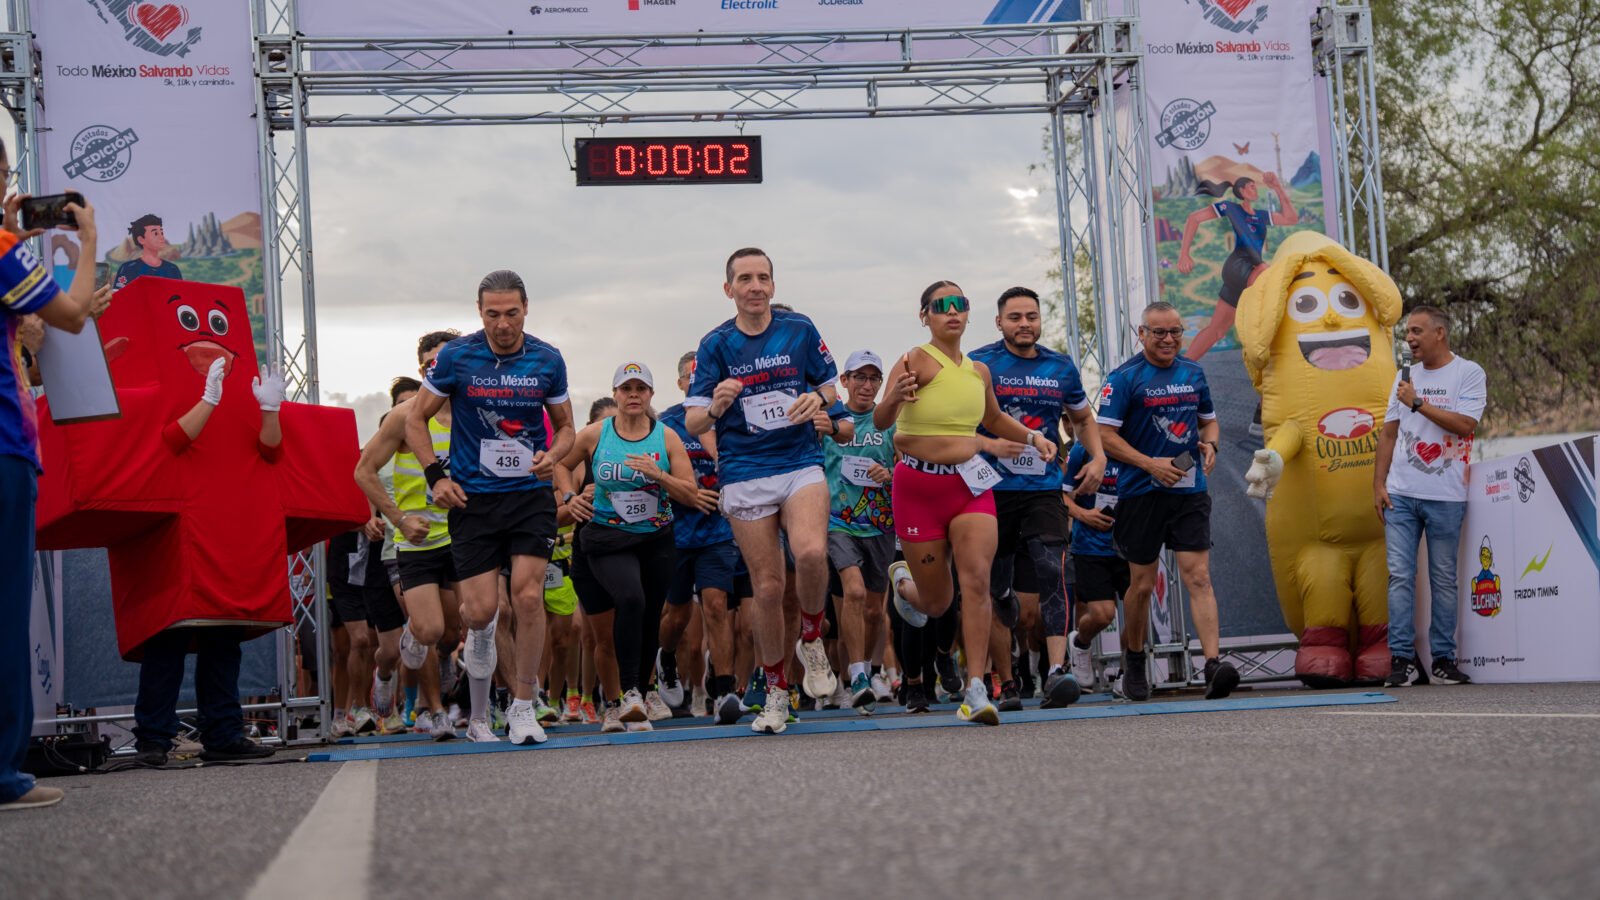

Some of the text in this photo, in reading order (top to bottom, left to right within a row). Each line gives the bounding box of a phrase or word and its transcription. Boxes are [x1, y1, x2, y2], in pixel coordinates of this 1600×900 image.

[720, 0, 778, 10] Electrolit
[1147, 41, 1290, 55] Todo México Salvando Vidas
[56, 64, 230, 78] Todo México Salvando Vidas
[1171, 104, 1214, 137] EDICIÓN
[82, 128, 109, 143] estados
[1185, 132, 1206, 148] 2026
[82, 131, 137, 168] EDICIÓN
[615, 144, 749, 175] 0:00:02
[99, 160, 125, 179] 2026
[728, 353, 791, 376] Todo México
[771, 367, 798, 378] Vidas
[471, 374, 539, 387] Todo México
[998, 375, 1059, 388] Todo México
[467, 385, 514, 398] Salvando
[995, 384, 1038, 397] Salvando
[1145, 383, 1195, 397] Todo México
[1422, 387, 1447, 395] México
[1143, 395, 1179, 408] Salvando
[762, 406, 785, 421] 113
[682, 441, 701, 450] odo
[838, 432, 883, 447] LAS
[496, 456, 520, 467] 436
[922, 460, 960, 475] UN
[977, 465, 993, 481] 499
[626, 503, 647, 515] 258
[1514, 585, 1559, 600] TRIZON TIMING
